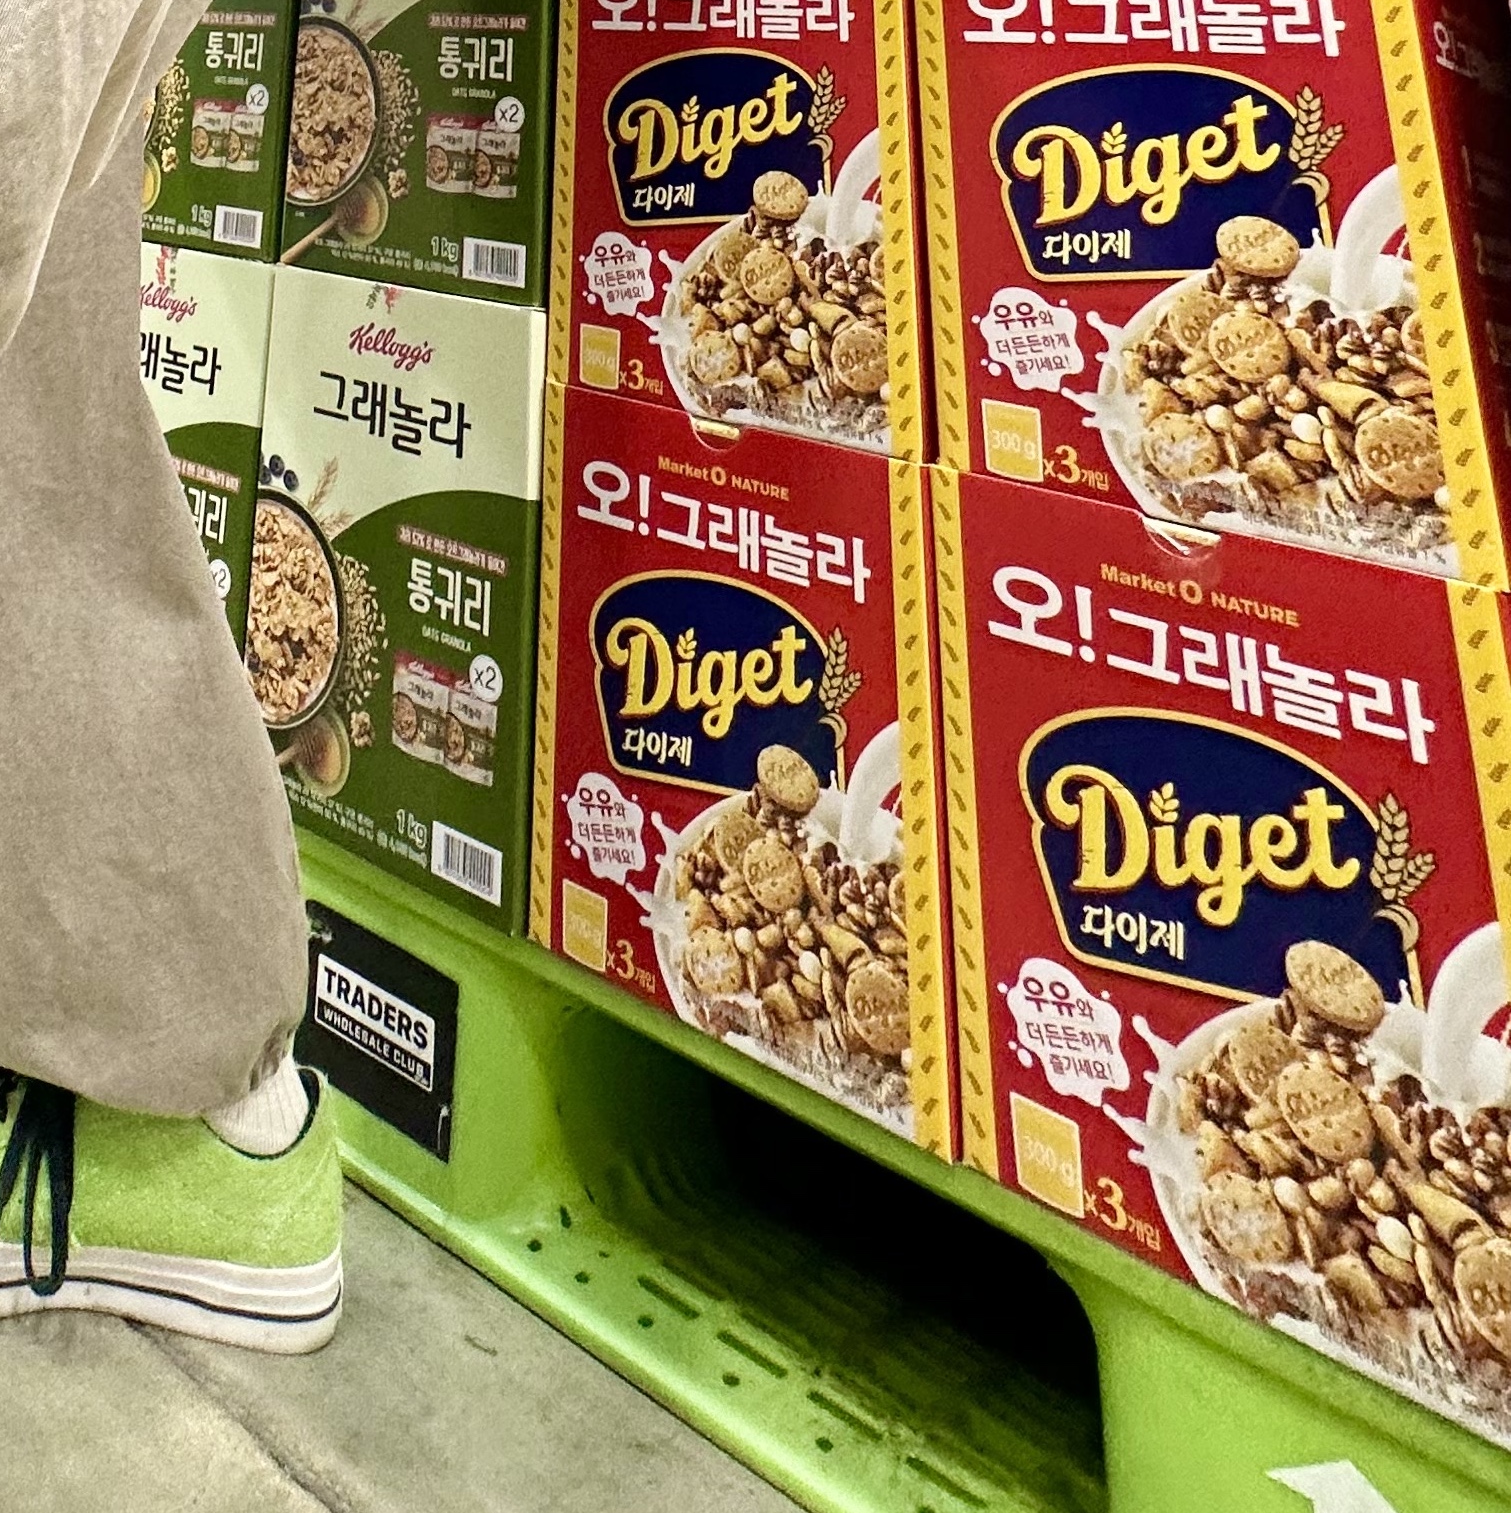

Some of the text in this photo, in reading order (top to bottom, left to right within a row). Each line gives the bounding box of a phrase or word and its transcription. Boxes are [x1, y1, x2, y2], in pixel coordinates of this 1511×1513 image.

[205, 31, 265, 72] 통귀리
[437, 36, 514, 82] 통귀리
[249, 90, 265, 107] x2
[499, 103, 519, 123] x2
[617, 71, 804, 185] Diget
[1012, 94, 1282, 227] Diget
[632, 183, 695, 213] 다이제
[1041, 229, 1132, 265] 다이제
[993, 302, 1055, 331] 우유와
[348, 322, 437, 373] Kellogg's
[1015, 355, 1070, 375] 즐기세요!
[313, 370, 472, 460] 그래놀라
[657, 455, 790, 502] Market O NATURE
[407, 557, 492, 637] 통귀리
[1099, 560, 1300, 628] Market O NATURE
[472, 663, 497, 691] x2
[605, 617, 814, 740] Diget
[622, 725, 693, 768] 다이제
[1045, 762, 1361, 928] Diget
[1080, 903, 1186, 962] 다이제
[324, 966, 429, 1050] TRADERS
[1022, 975, 1095, 1022] 우유와
[322, 1005, 425, 1078] WHOLESALE CLUB
[1048, 1054, 1115, 1083] 즐기세요!
